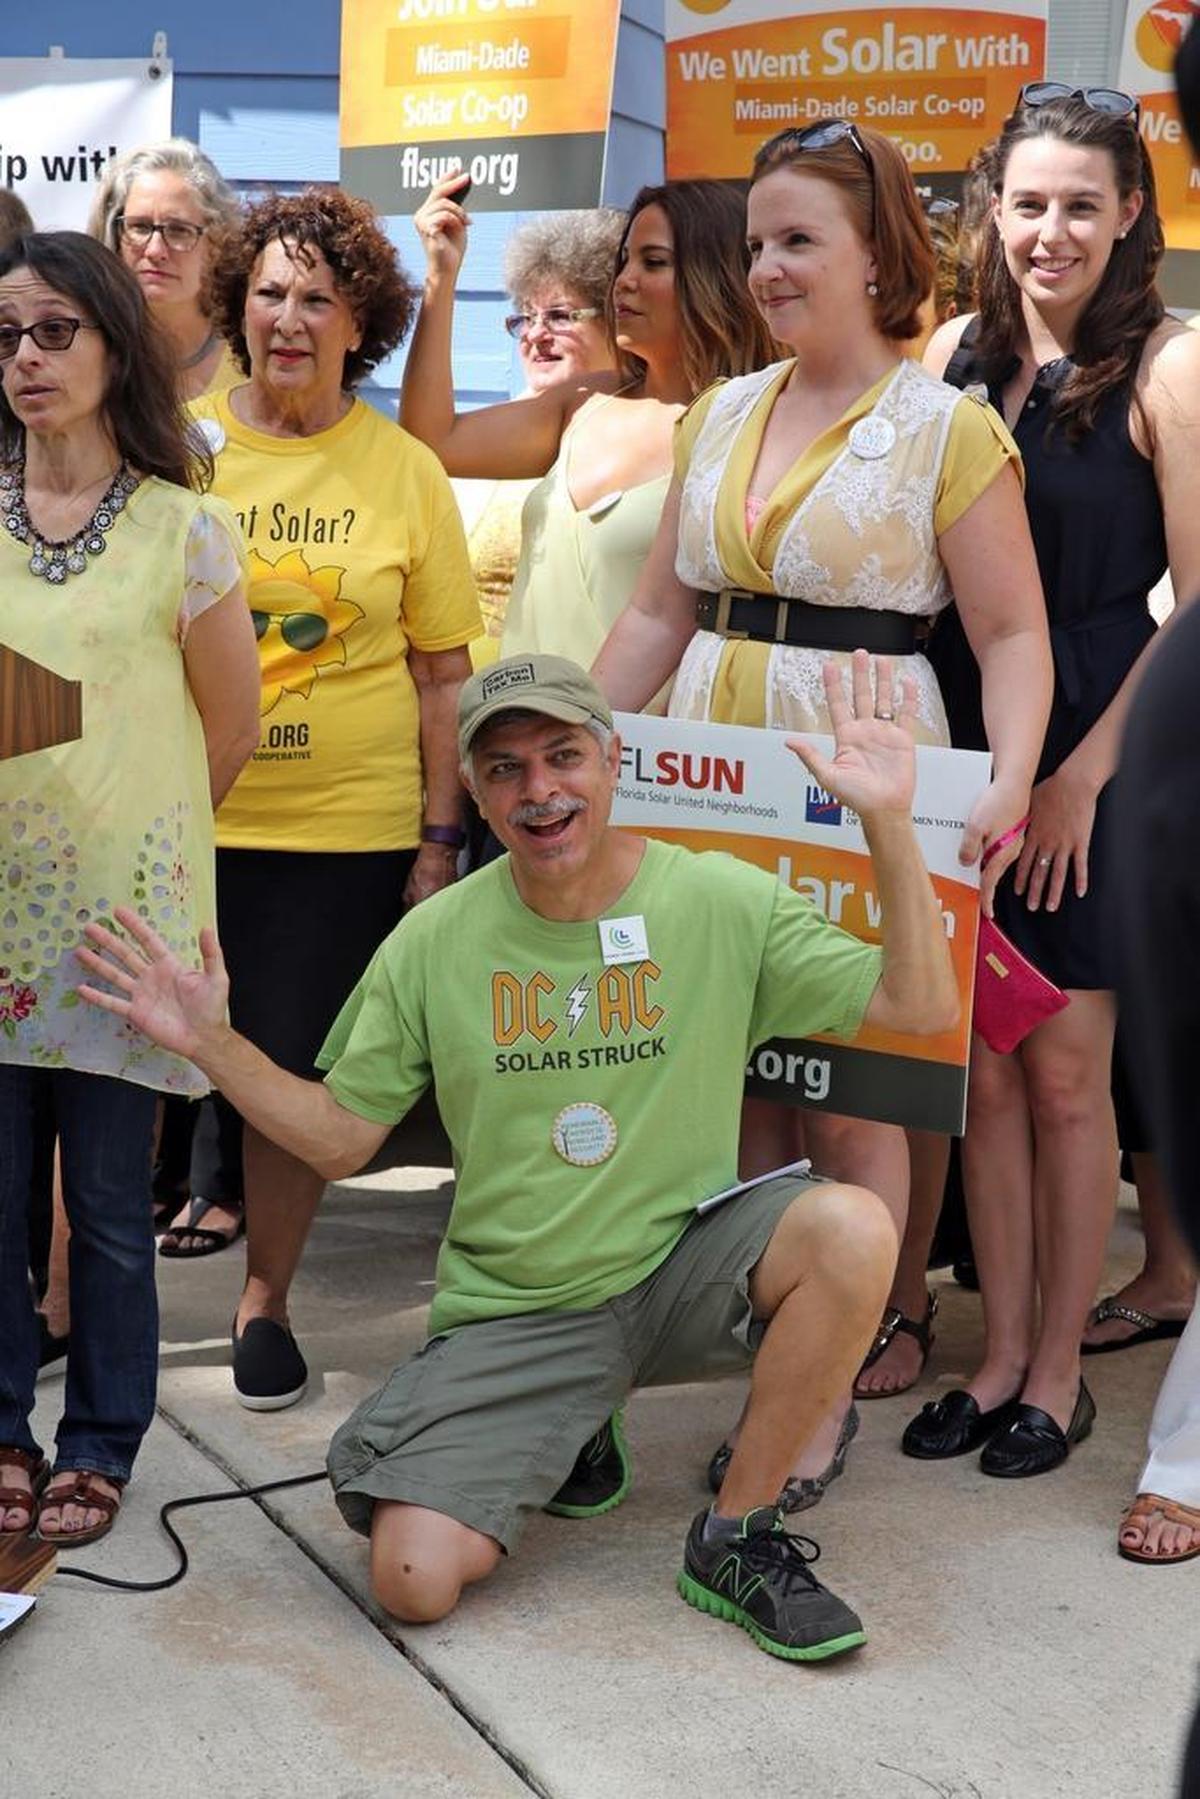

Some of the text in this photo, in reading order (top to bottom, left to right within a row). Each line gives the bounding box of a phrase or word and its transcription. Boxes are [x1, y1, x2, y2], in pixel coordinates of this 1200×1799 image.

[415, 39, 530, 75] Miami-Dade
[679, 22, 1030, 81] We Went Solar With
[402, 89, 529, 130] Solar Co-op
[735, 94, 985, 120] Miami-Dade Solar Co-op
[1138, 111, 1181, 144] We
[0, 145, 117, 189] p wit
[401, 147, 519, 196] flsunorg
[269, 503, 356, 544] Solar?
[252, 751, 312, 761] COOPERATIVE
[618, 746, 744, 795] FLSUN
[616, 786, 779, 819] Florida Solar United Neighborhoods
[492, 960, 665, 1046] DC AC
[495, 1036, 666, 1074] SOLAR STRUCK
